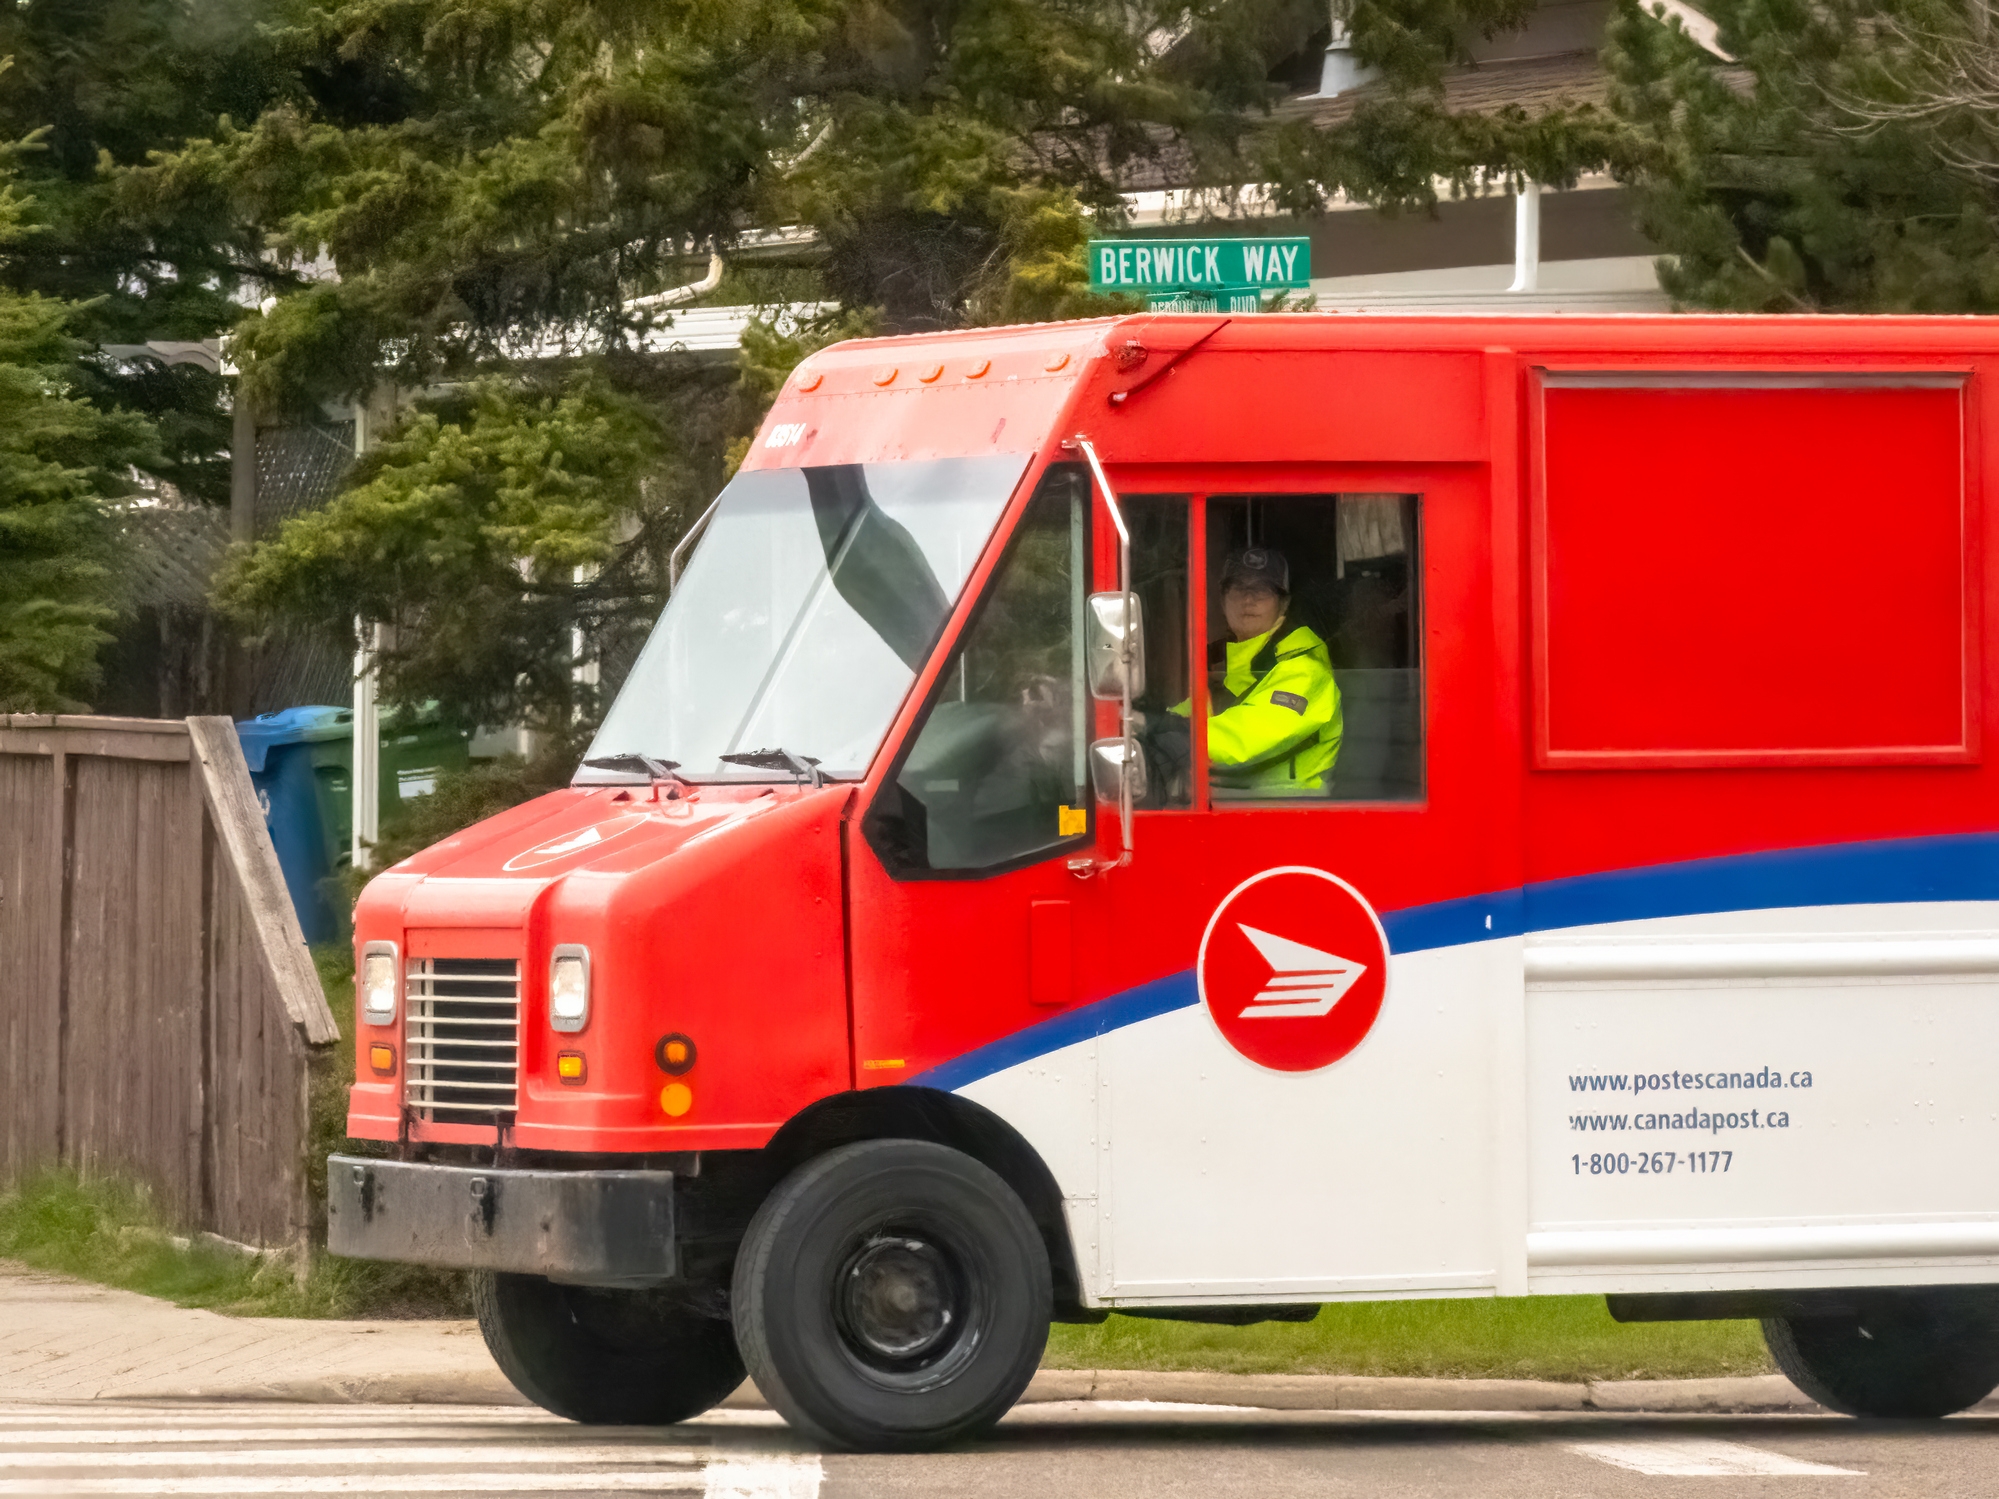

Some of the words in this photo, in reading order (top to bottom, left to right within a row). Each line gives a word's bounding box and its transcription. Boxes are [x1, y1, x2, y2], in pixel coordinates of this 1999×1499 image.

[1101, 246, 1221, 284] BERWICK
[1242, 245, 1298, 282] WAY
[1568, 1066, 1813, 1096] www.postescanada.ca
[1568, 1107, 1790, 1135] www.canadapost.ca
[1571, 1151, 1733, 1175] 1-800-267-1177
